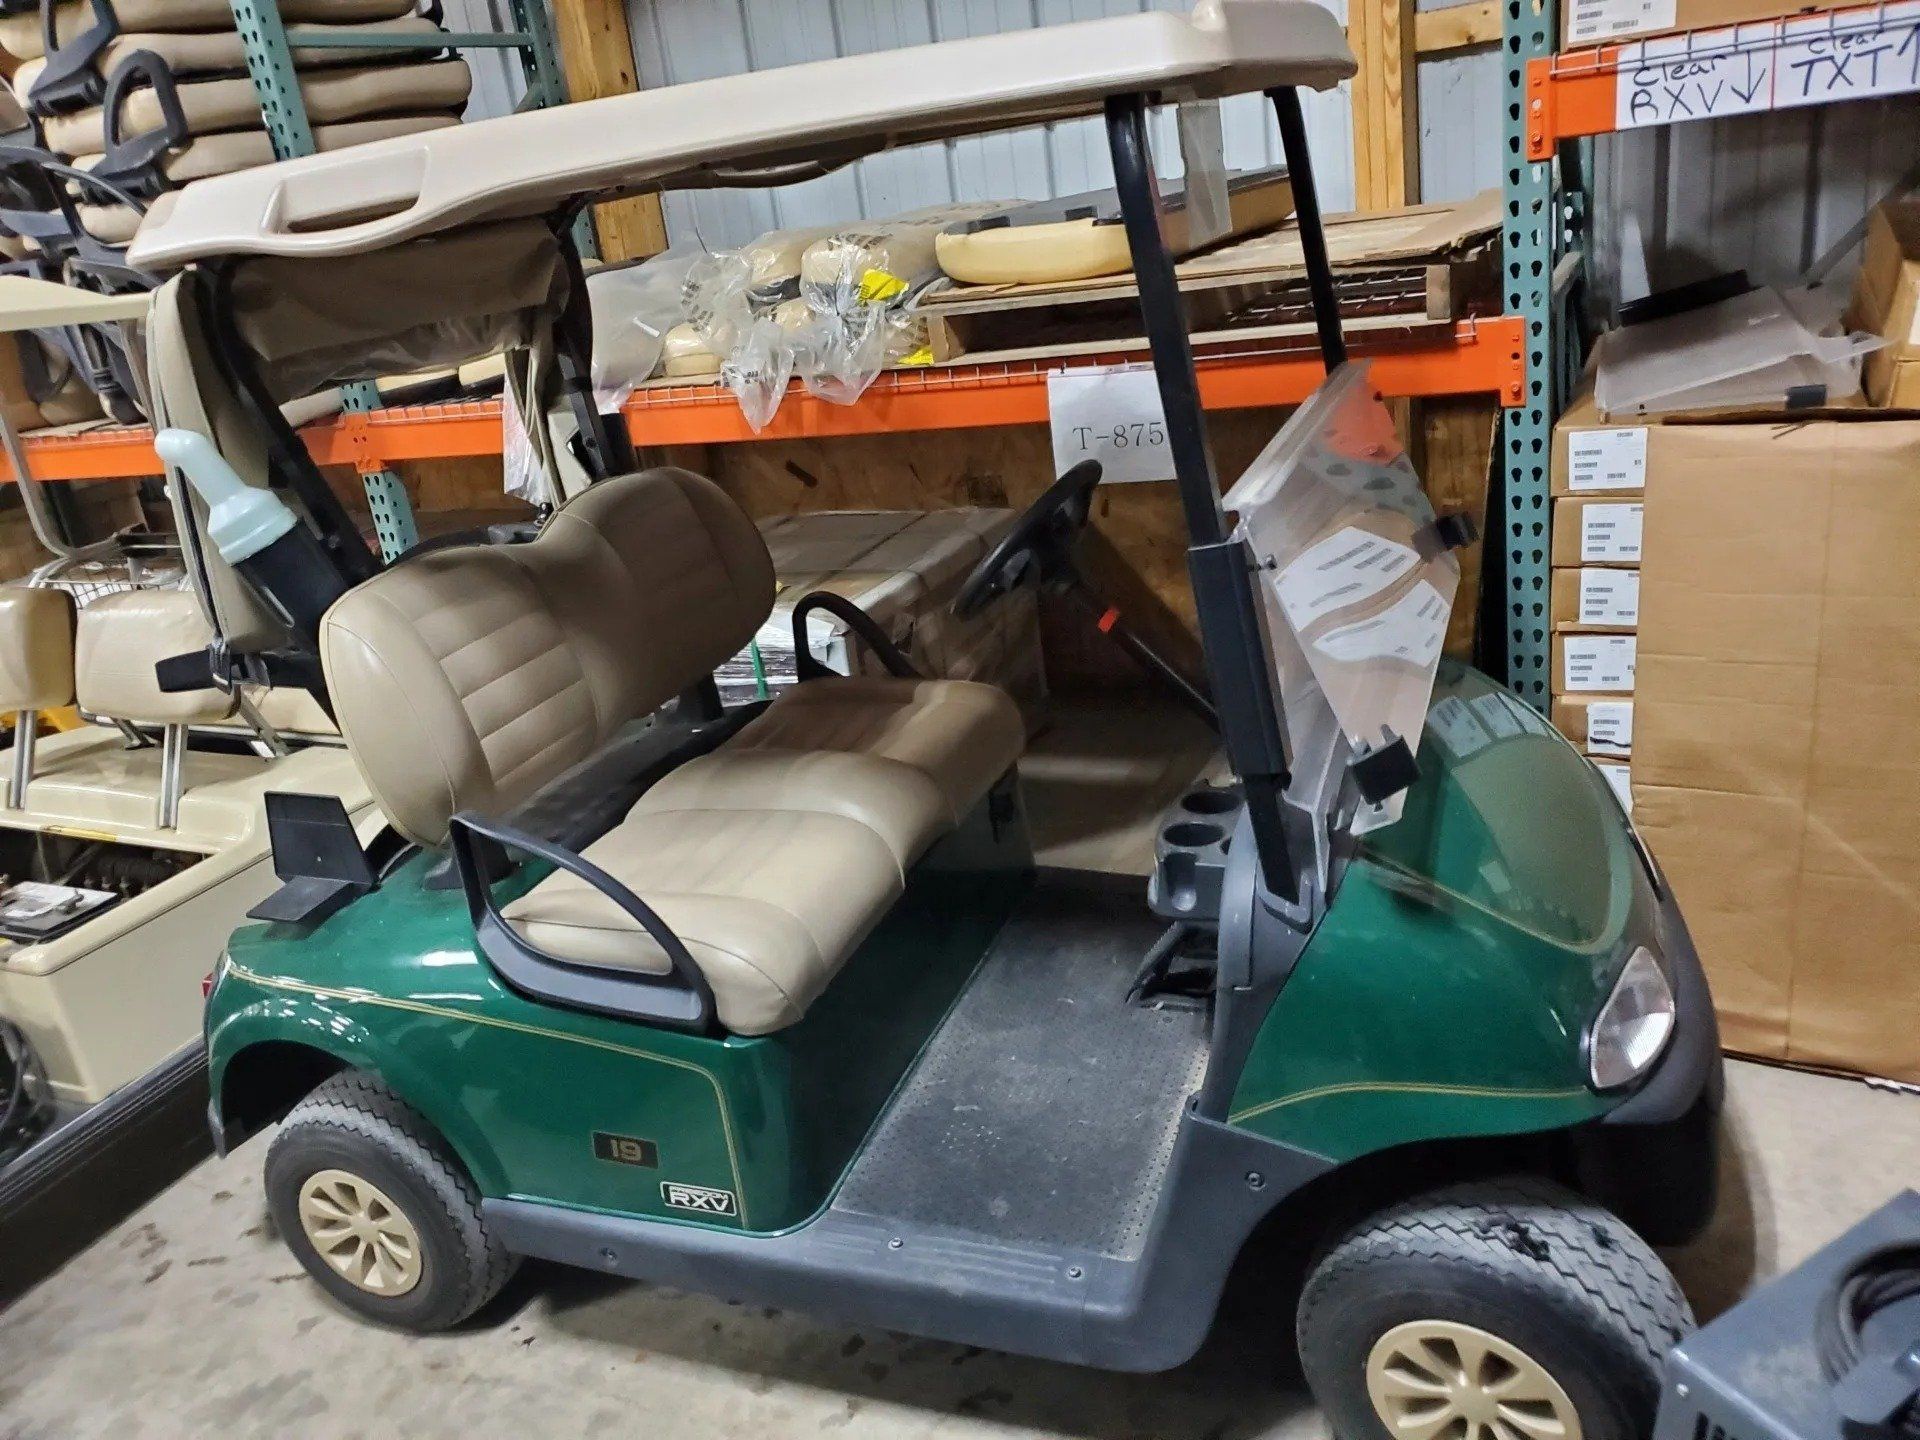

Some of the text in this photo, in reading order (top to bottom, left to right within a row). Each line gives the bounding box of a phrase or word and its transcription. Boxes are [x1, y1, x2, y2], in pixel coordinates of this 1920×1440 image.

[1633, 54, 1727, 87] Clear
[1791, 44, 1893, 96] TXT
[1630, 79, 1724, 123] RXV
[1072, 421, 1164, 451] T-875
[610, 1139, 642, 1161] 19
[670, 1191, 729, 1212] RXV
